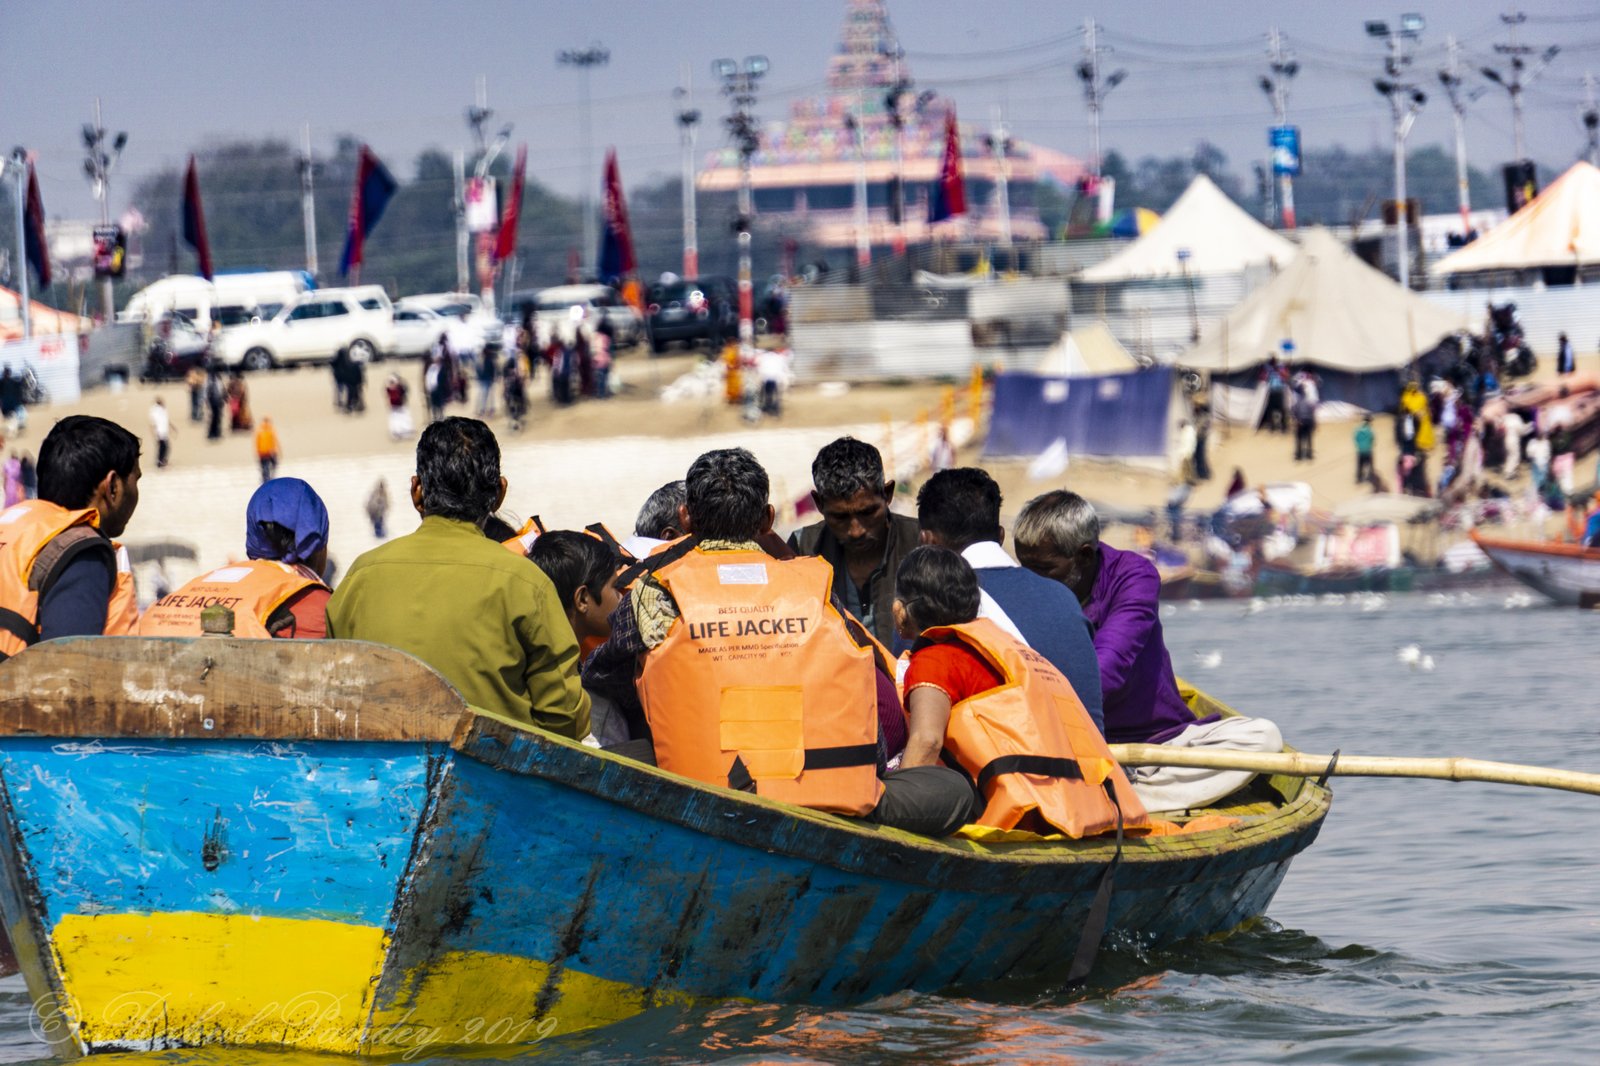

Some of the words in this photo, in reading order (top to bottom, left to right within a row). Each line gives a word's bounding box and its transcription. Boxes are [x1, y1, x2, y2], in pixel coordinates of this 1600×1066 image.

[155, 595, 189, 608] LIFE
[718, 606, 738, 615] BEST
[740, 605, 775, 614] QUALITY
[689, 621, 730, 640] LIFE
[736, 617, 808, 637] JACKET
[698, 646, 717, 654] MADE
[719, 645, 728, 653] AS
[728, 644, 741, 652] PER
